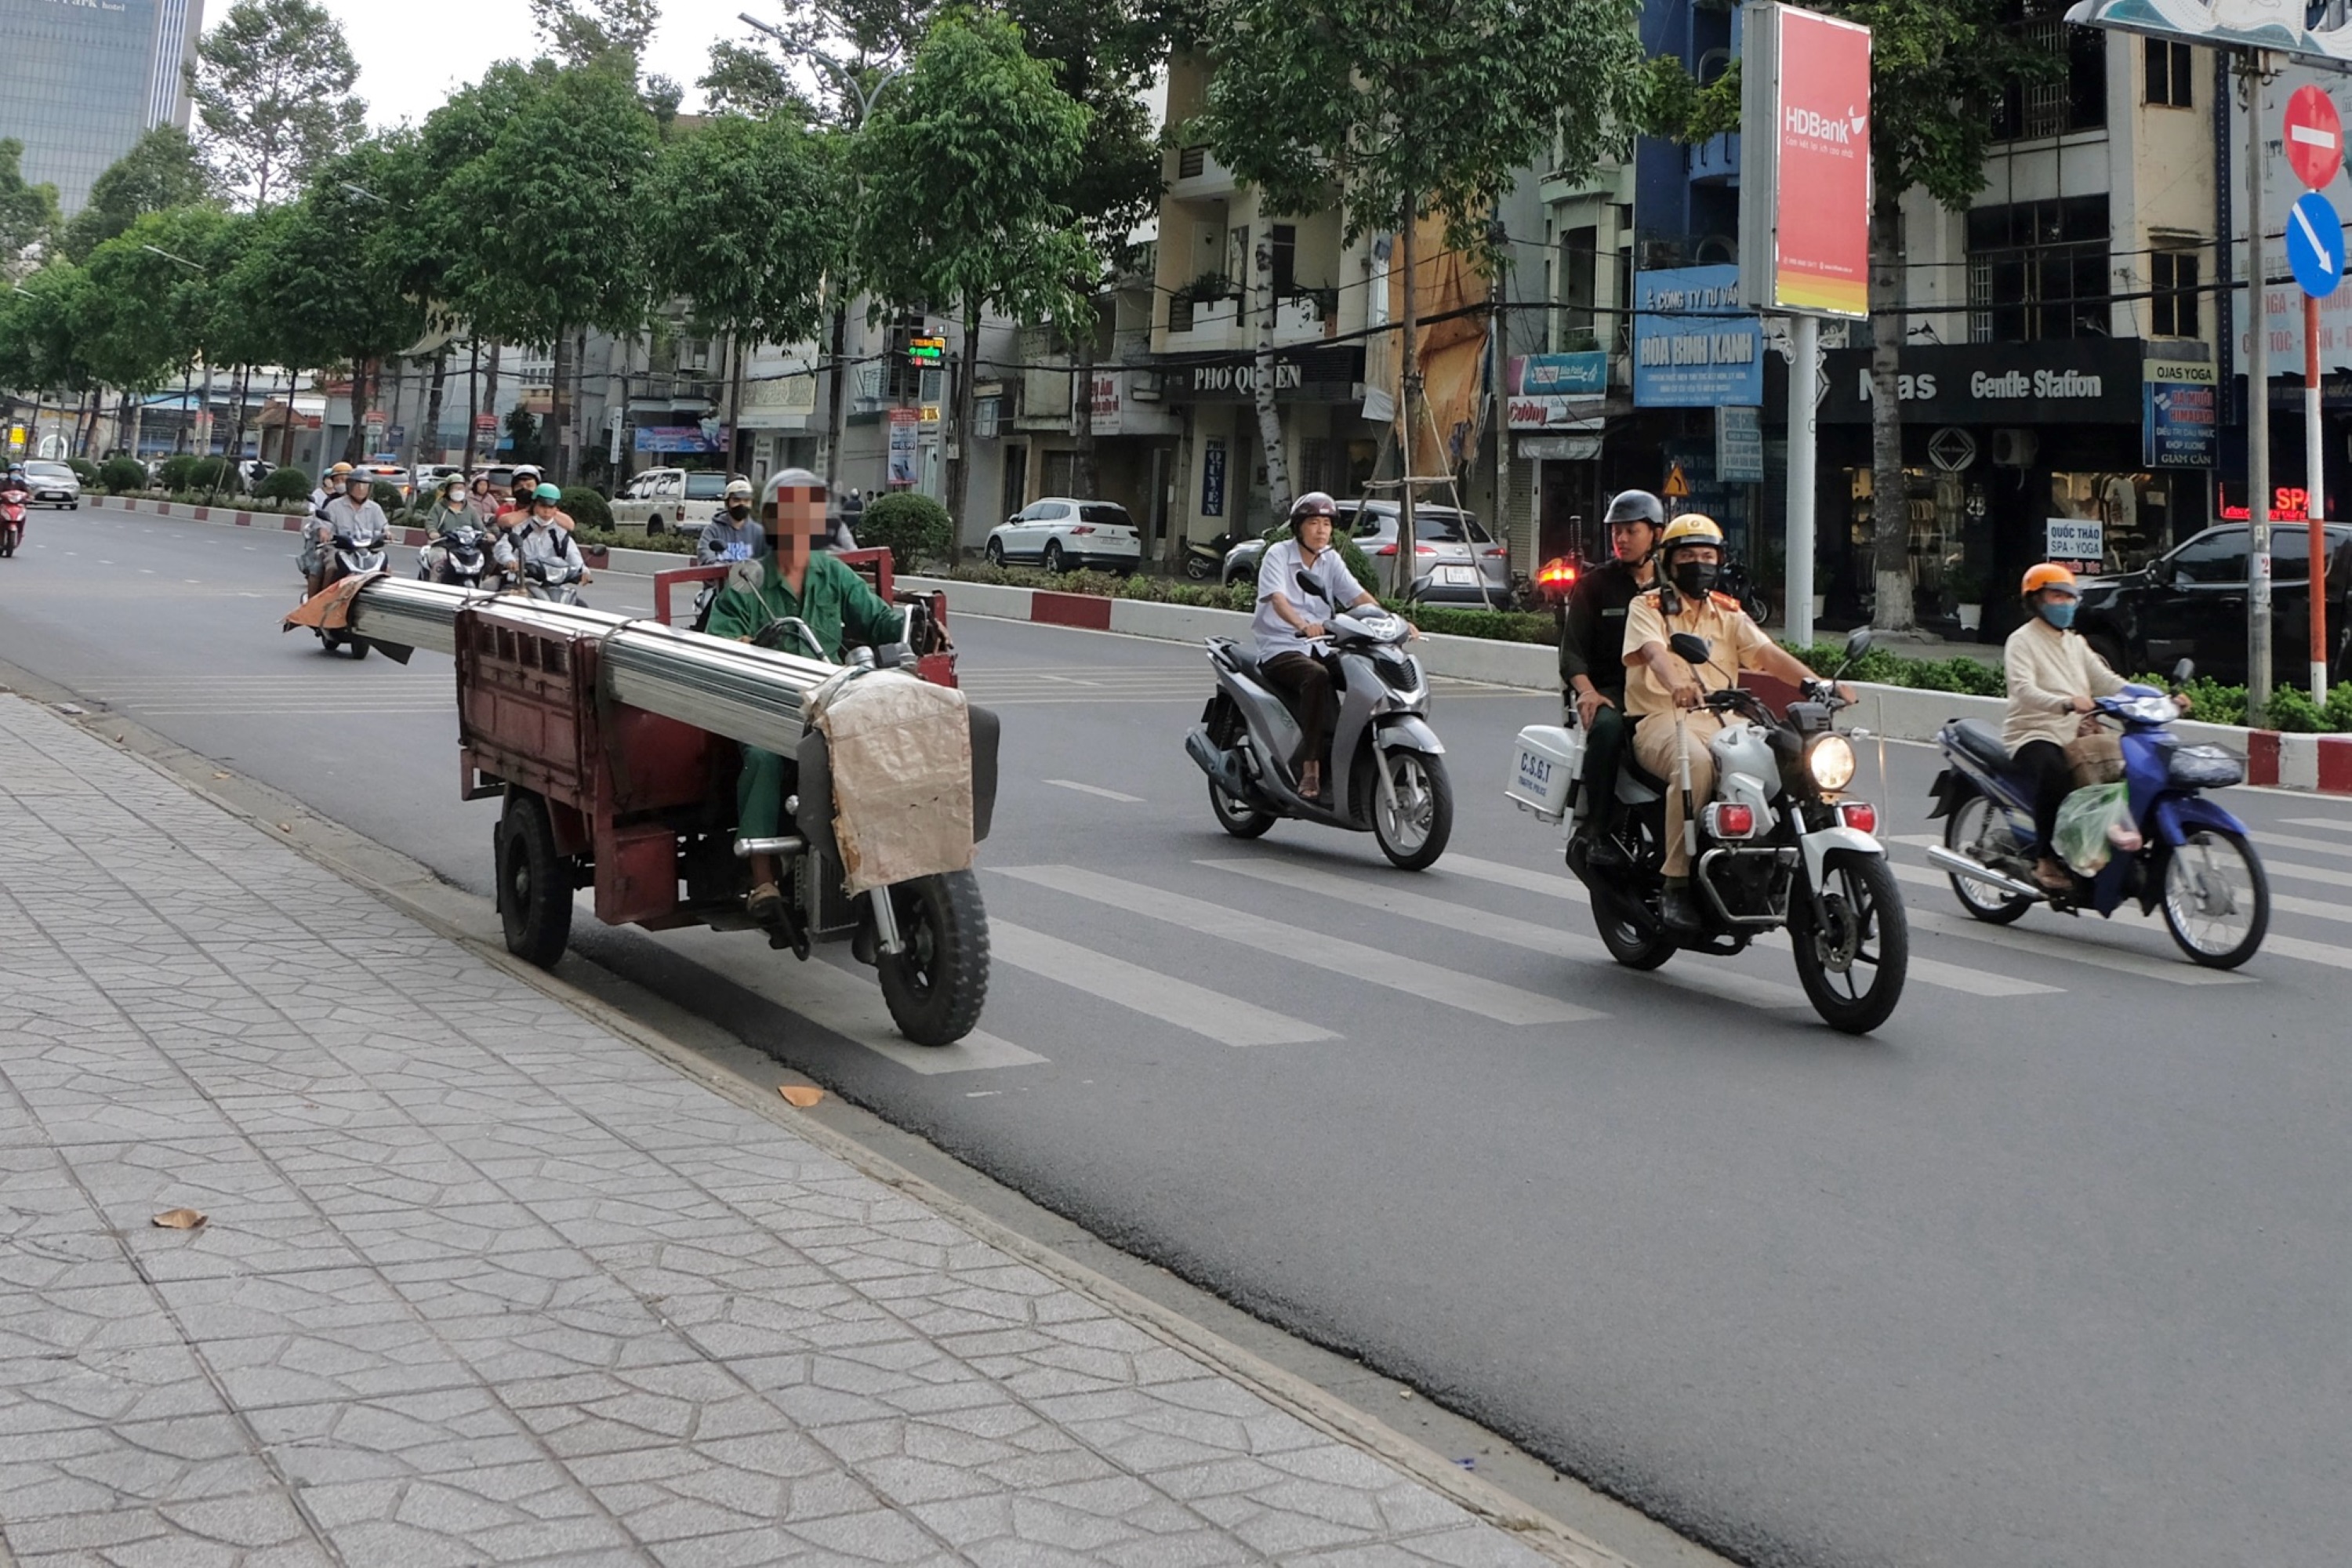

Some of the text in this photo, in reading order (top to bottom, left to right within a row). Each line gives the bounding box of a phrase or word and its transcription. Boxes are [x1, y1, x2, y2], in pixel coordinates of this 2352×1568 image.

[102, 1, 125, 12] hotel
[1785, 106, 1849, 144] HDBank
[1658, 288, 1685, 309] CÔNG
[1688, 289, 1702, 308] TY
[1641, 330, 1671, 366] HÒA
[1672, 331, 1708, 365] BÌNH
[2157, 367, 2212, 380] OJAS YOGA
[1970, 369, 2102, 398] Gentle Station
[2169, 408, 2215, 423] HIMALAYA
[2051, 523, 2100, 539] QUỐC THẢO
[2051, 540, 2068, 553] SPA
[2075, 541, 2100, 554] YOGA
[1521, 753, 1552, 783] C.S.G.T
